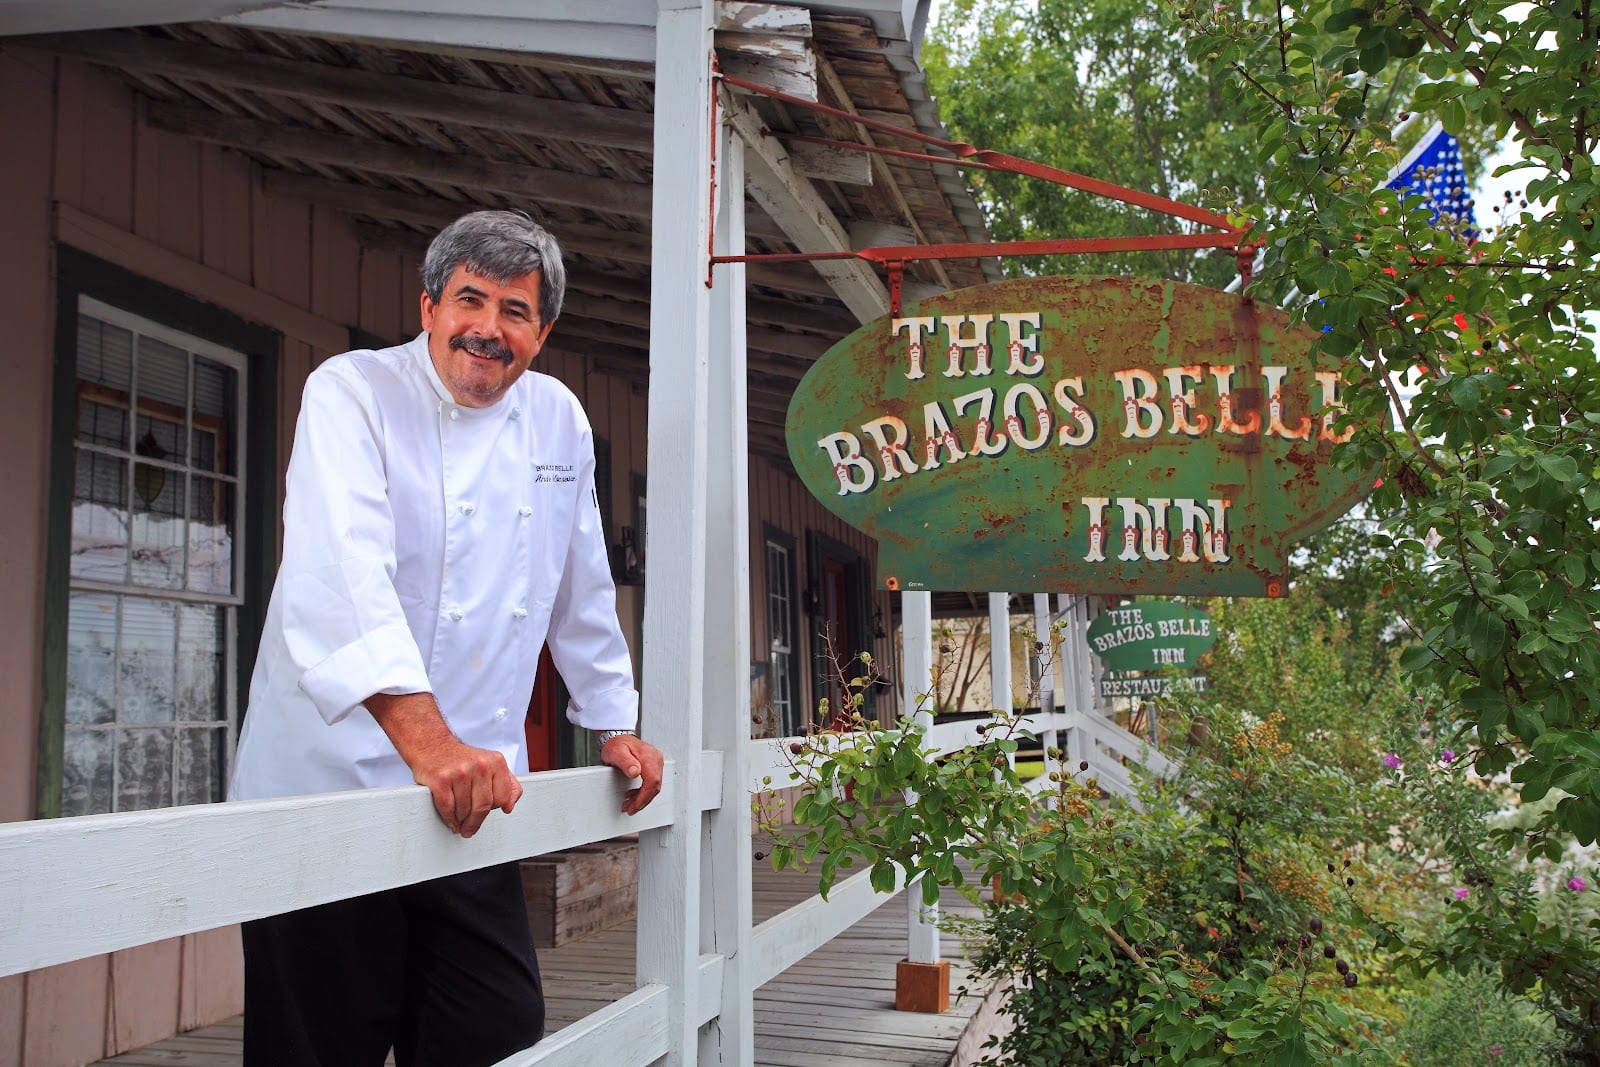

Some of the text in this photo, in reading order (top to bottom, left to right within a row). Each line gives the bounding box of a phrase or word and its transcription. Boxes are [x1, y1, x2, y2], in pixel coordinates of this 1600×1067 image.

[892, 312, 1045, 380] THE
[817, 364, 1356, 496] BRAZOS BELLE
[1081, 497, 1231, 564] INN
[1094, 619, 1210, 652] BRAZOS BELLE
[1108, 609, 1144, 626] THE
[1152, 648, 1185, 664] INN
